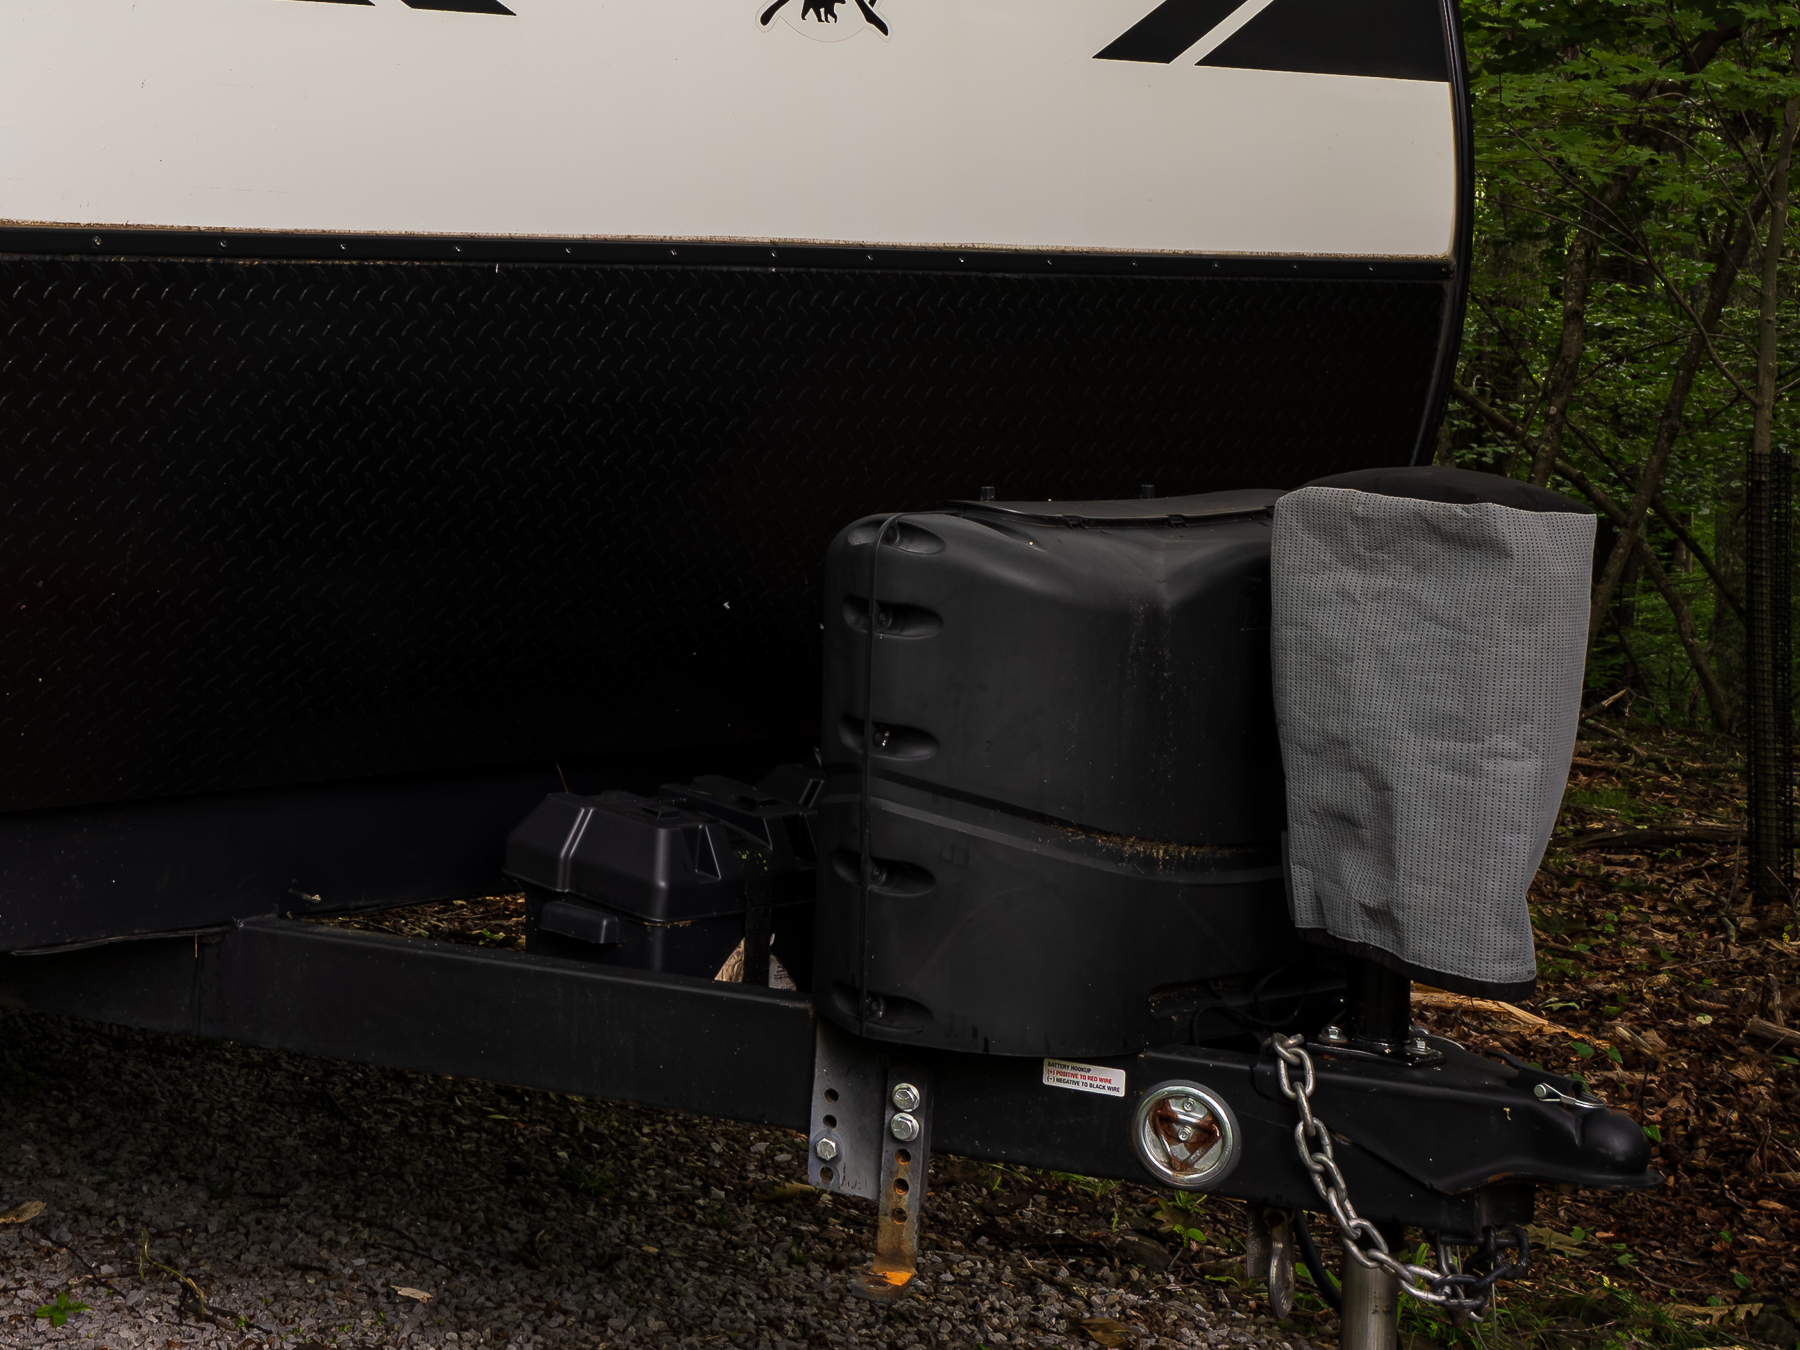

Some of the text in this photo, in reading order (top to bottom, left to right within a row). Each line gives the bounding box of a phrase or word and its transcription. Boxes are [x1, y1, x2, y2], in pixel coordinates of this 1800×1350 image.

[1047, 1061, 1092, 1074] BATTERY HOOKUP
[1056, 1070, 1078, 1080] POSITIVE
[1099, 1076, 1112, 1085] WIRE
[1056, 1077, 1080, 1087] NEGATIVE
[1081, 1080, 1088, 1088] TO
[1089, 1081, 1106, 1091] BLACK
[1107, 1084, 1121, 1093] WIRE
